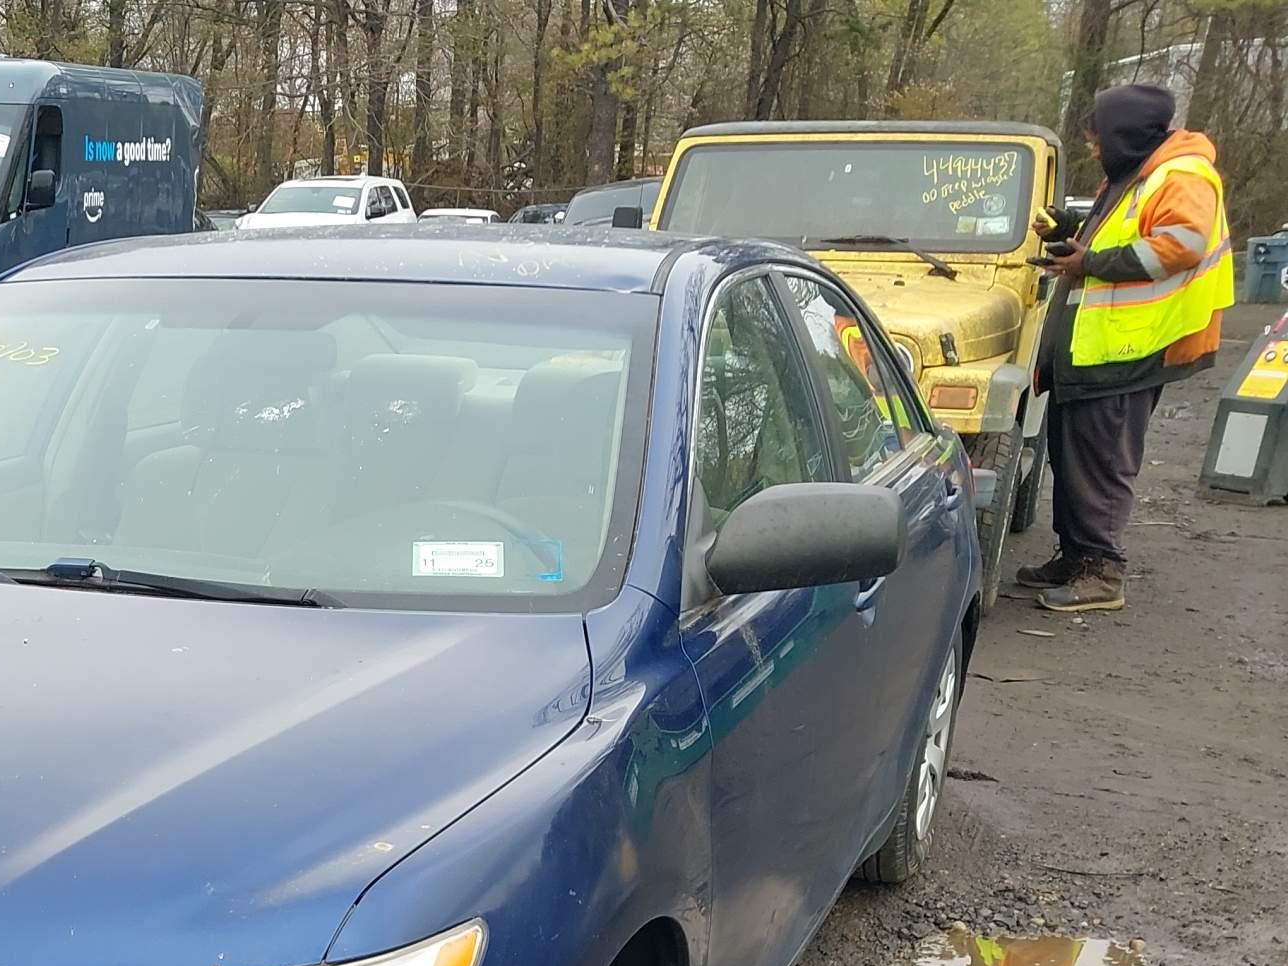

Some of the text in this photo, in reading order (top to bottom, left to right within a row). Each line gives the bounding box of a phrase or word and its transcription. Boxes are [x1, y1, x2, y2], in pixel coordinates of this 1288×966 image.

[85, 135, 172, 167] Is now a good time?
[924, 151, 1017, 185] 44944437
[83, 187, 105, 212] prime
